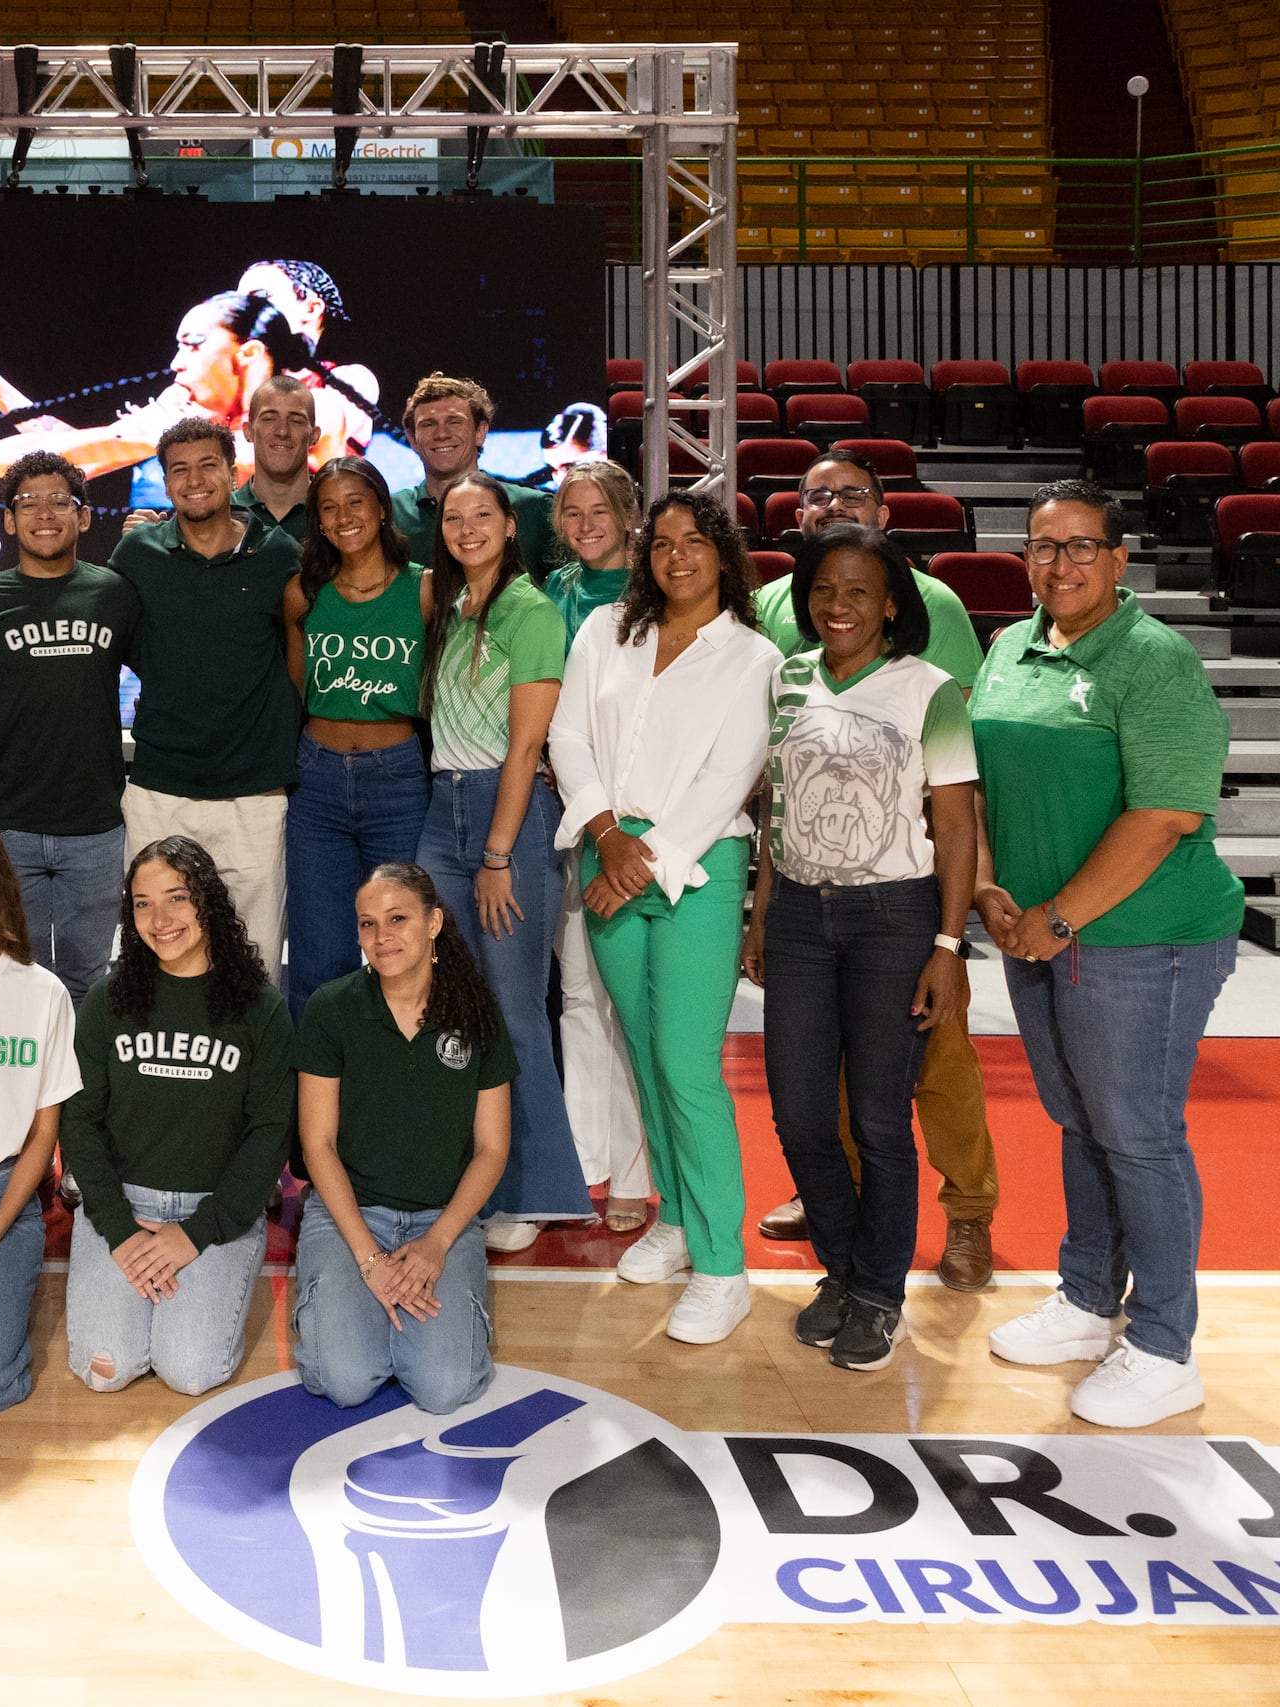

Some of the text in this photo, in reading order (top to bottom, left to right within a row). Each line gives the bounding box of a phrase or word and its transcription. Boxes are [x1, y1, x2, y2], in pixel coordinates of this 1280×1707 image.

[4, 619, 113, 652] COLEGIO
[32, 646, 91, 655] CHEERLEADING
[306, 633, 418, 665] YO SOY
[314, 656, 398, 705] Colegio
[789, 854, 837, 879] TARZAN
[114, 1031, 241, 1073] COLEGIO
[141, 1065, 210, 1078] CHEERLEADING
[723, 1437, 1280, 1539] DR. J
[776, 1557, 1280, 1616] CIRUJAN
